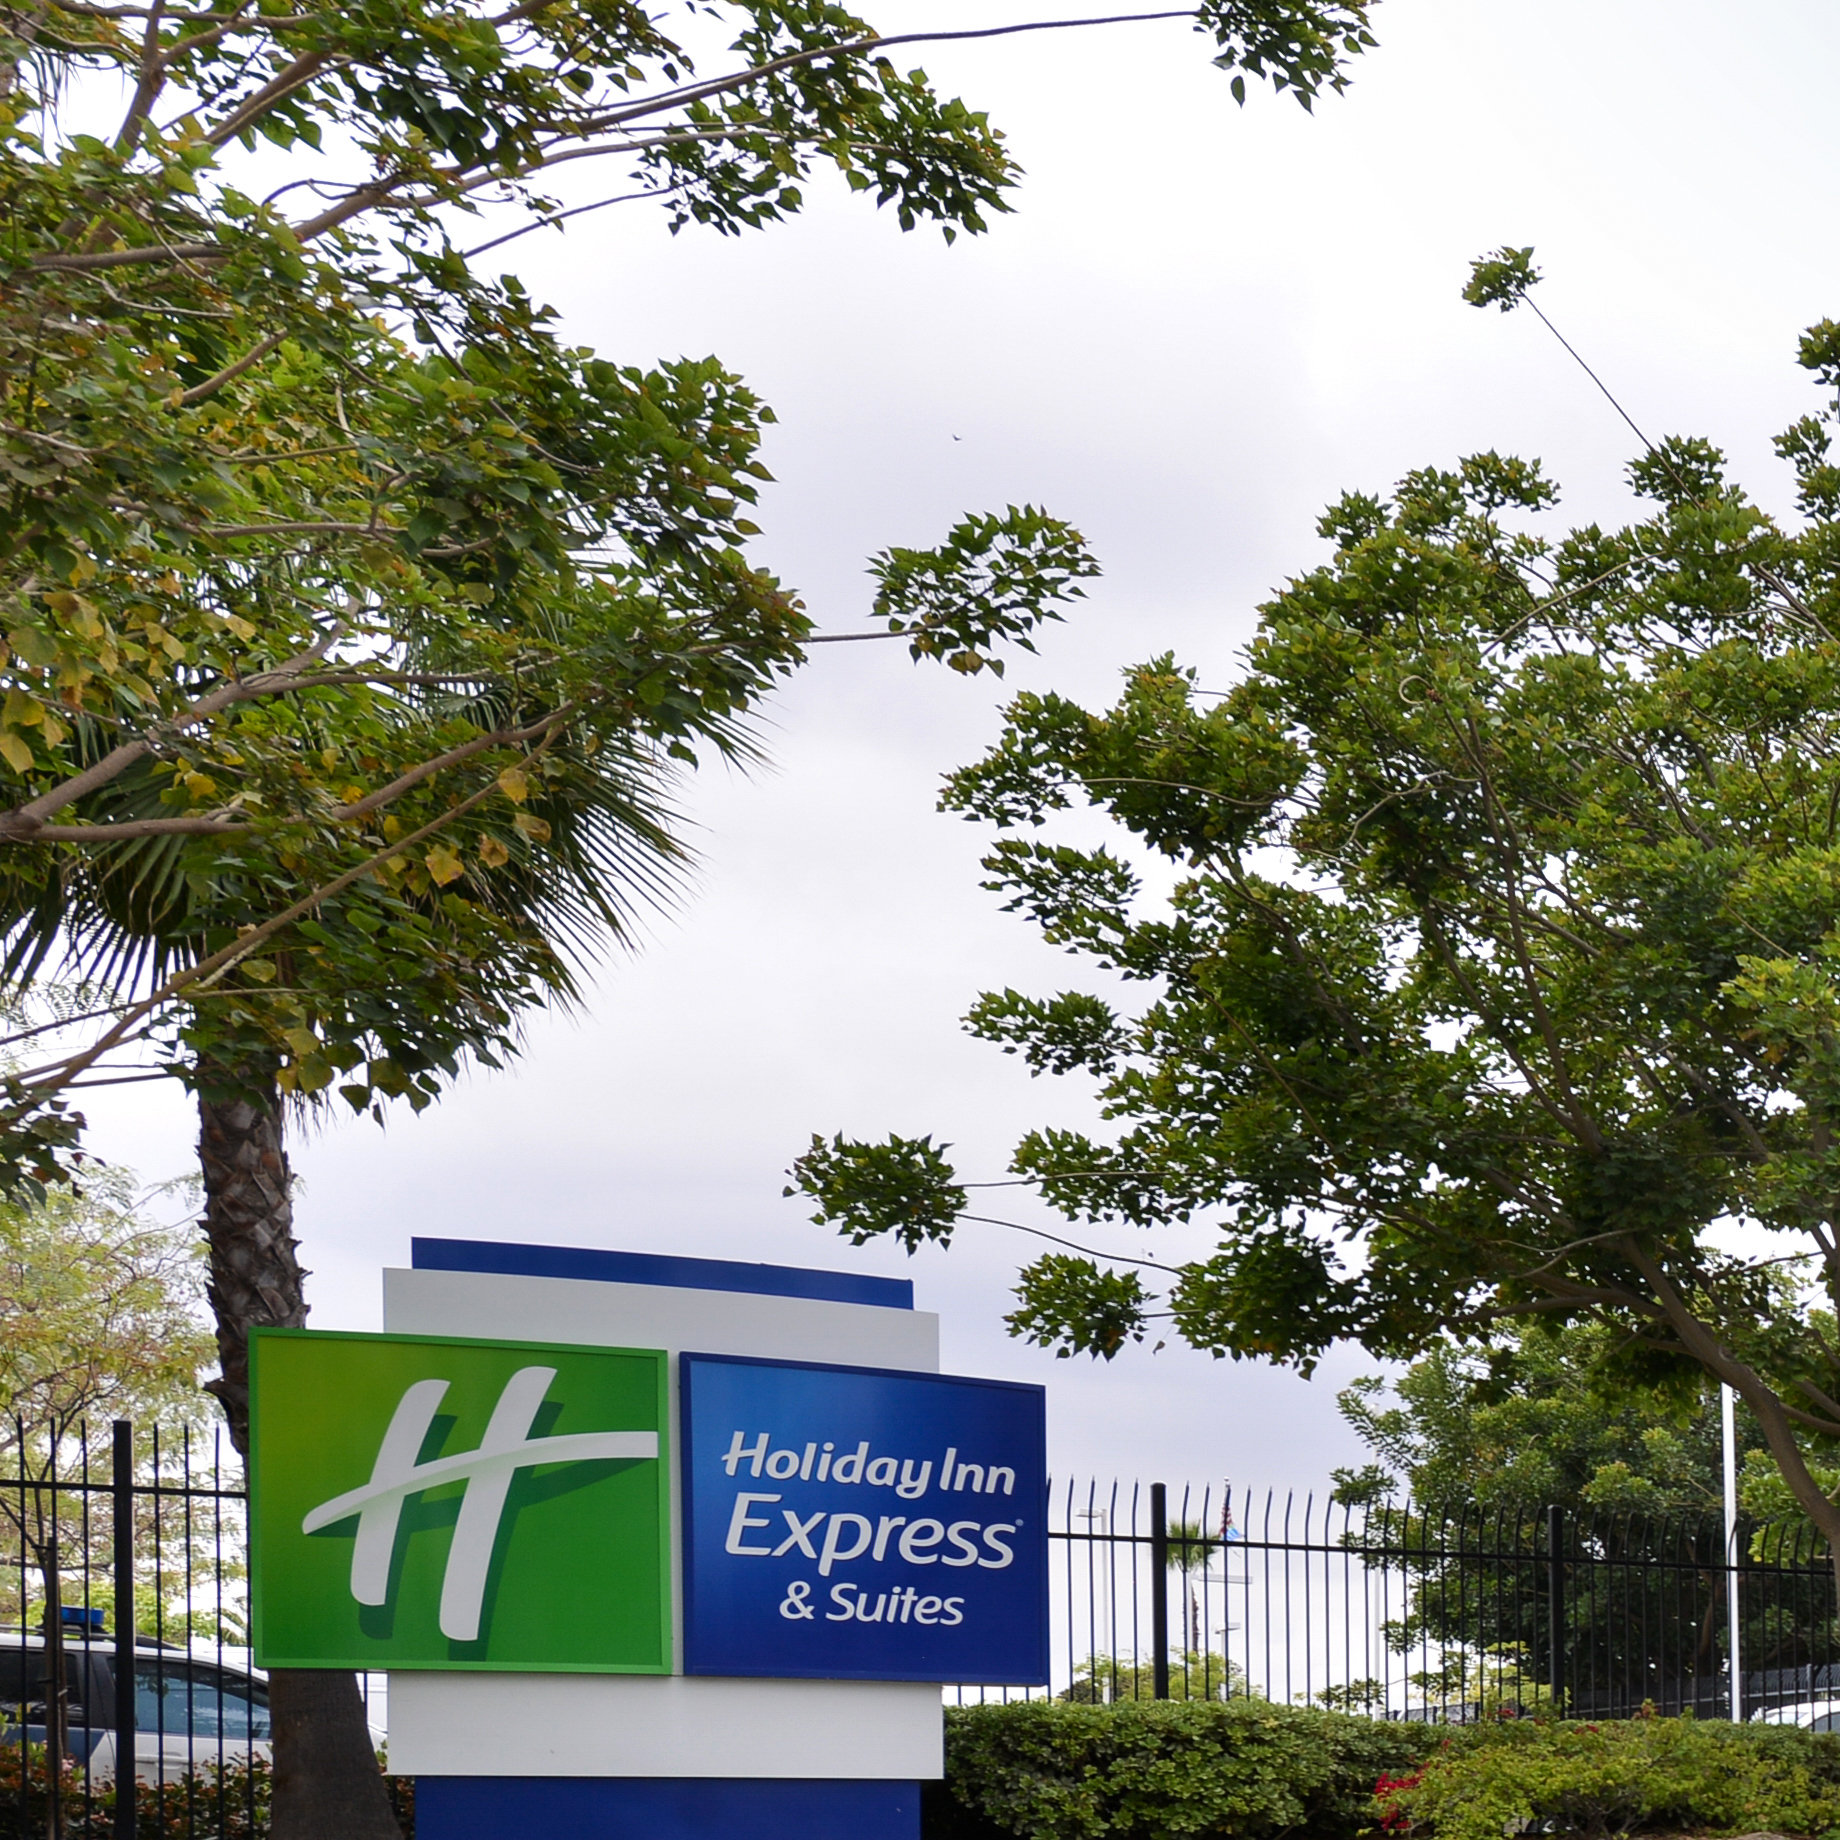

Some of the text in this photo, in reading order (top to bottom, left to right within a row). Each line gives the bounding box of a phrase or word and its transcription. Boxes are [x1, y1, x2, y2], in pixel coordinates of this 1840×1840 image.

[721, 1430, 1015, 1499] Holiday Inn
[725, 1491, 1017, 1577] Express
[779, 1580, 965, 1626] & Suites
